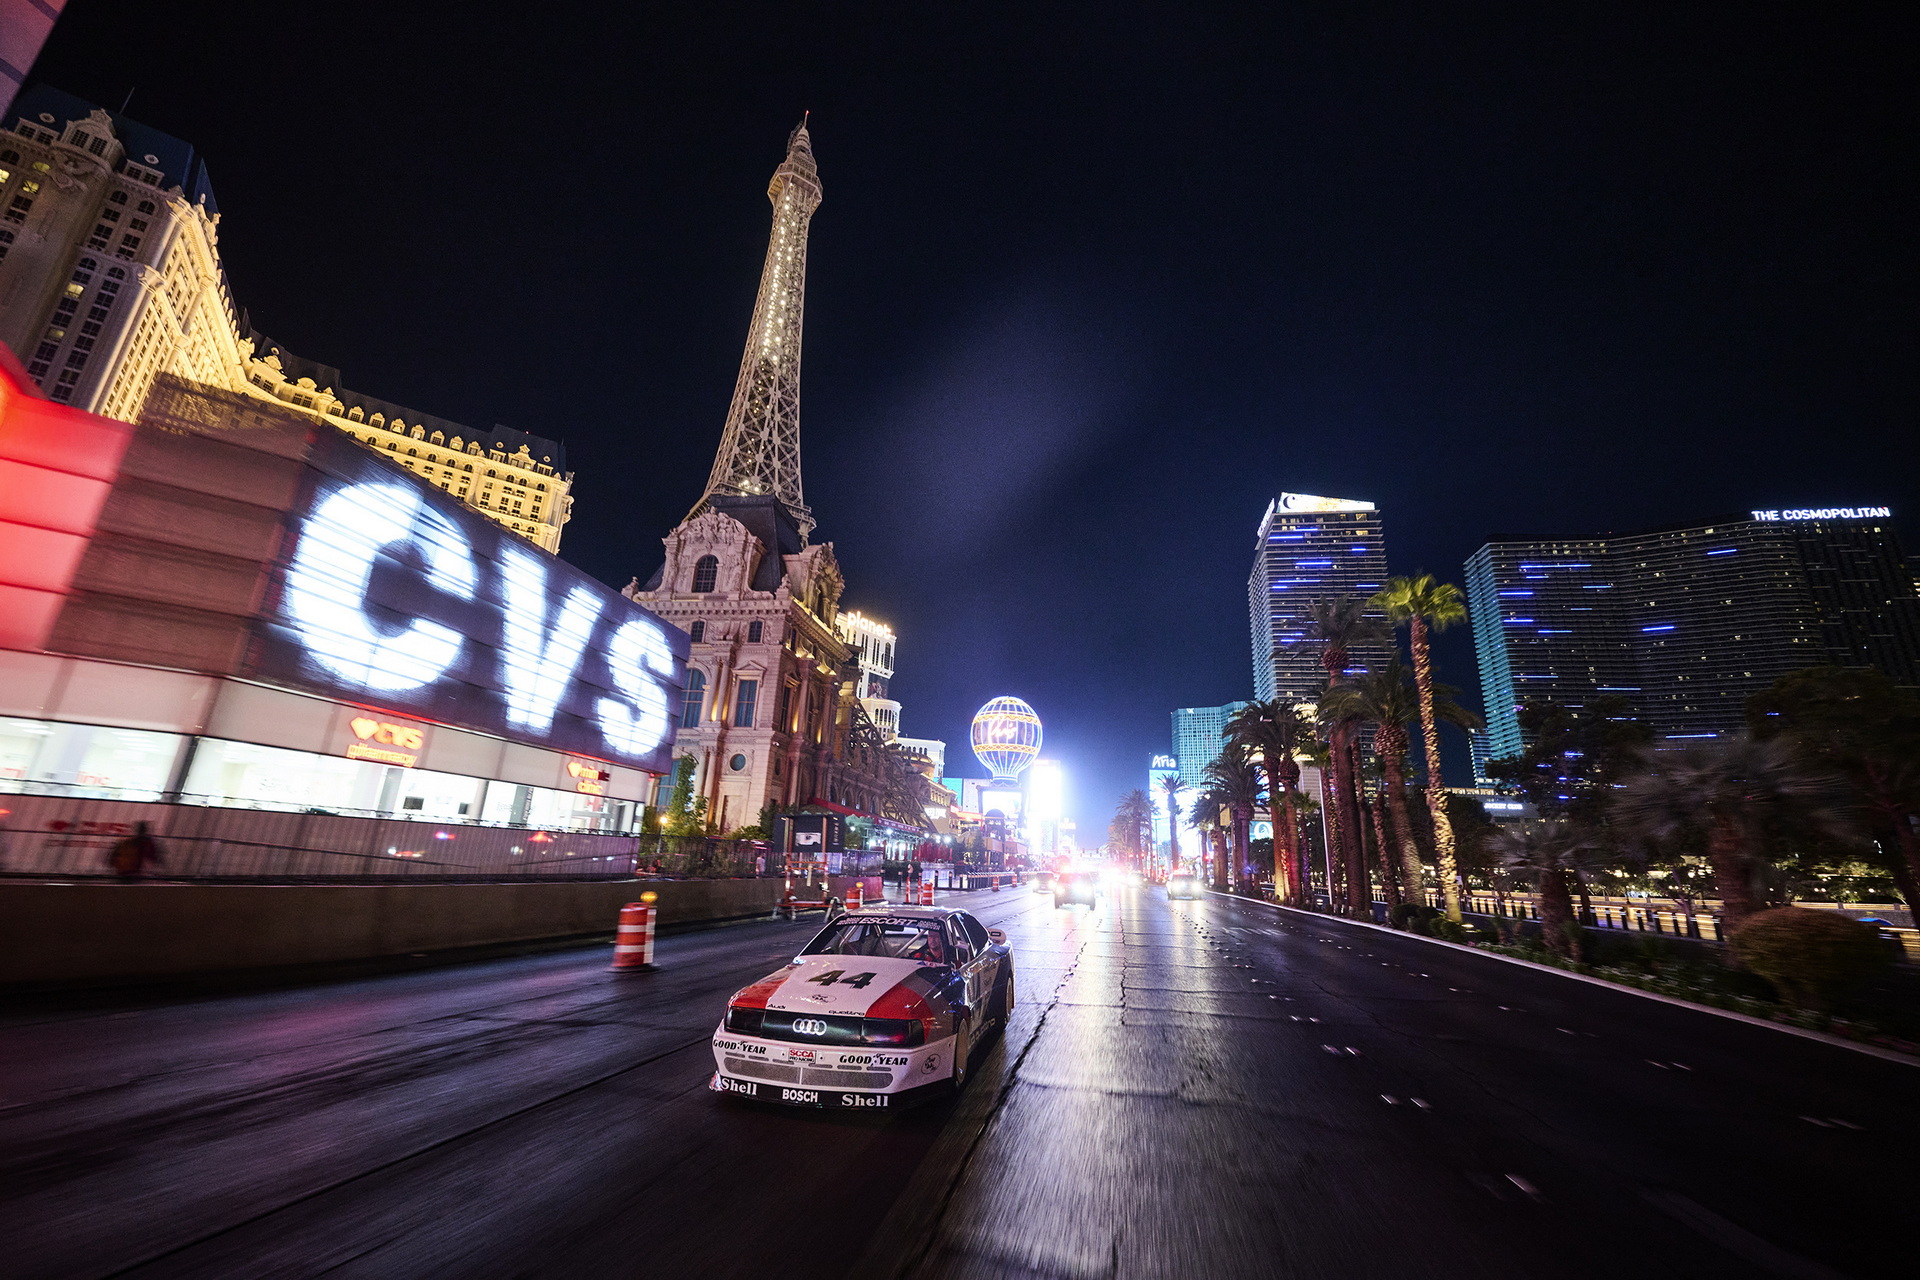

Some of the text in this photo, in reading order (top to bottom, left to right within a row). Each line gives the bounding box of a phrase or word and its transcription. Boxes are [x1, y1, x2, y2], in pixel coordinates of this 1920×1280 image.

[1751, 506, 1890, 521] THE COSMOPOLITAN
[290, 481, 675, 758] CVS
[373, 722, 425, 750] CVS
[859, 917, 918, 926] ESCORT
[805, 970, 878, 990] 44
[789, 1049, 814, 1058] SCCA
[721, 1078, 758, 1096] Shell
[782, 1088, 818, 1103] BOSCH
[841, 1094, 889, 1107] Shell
